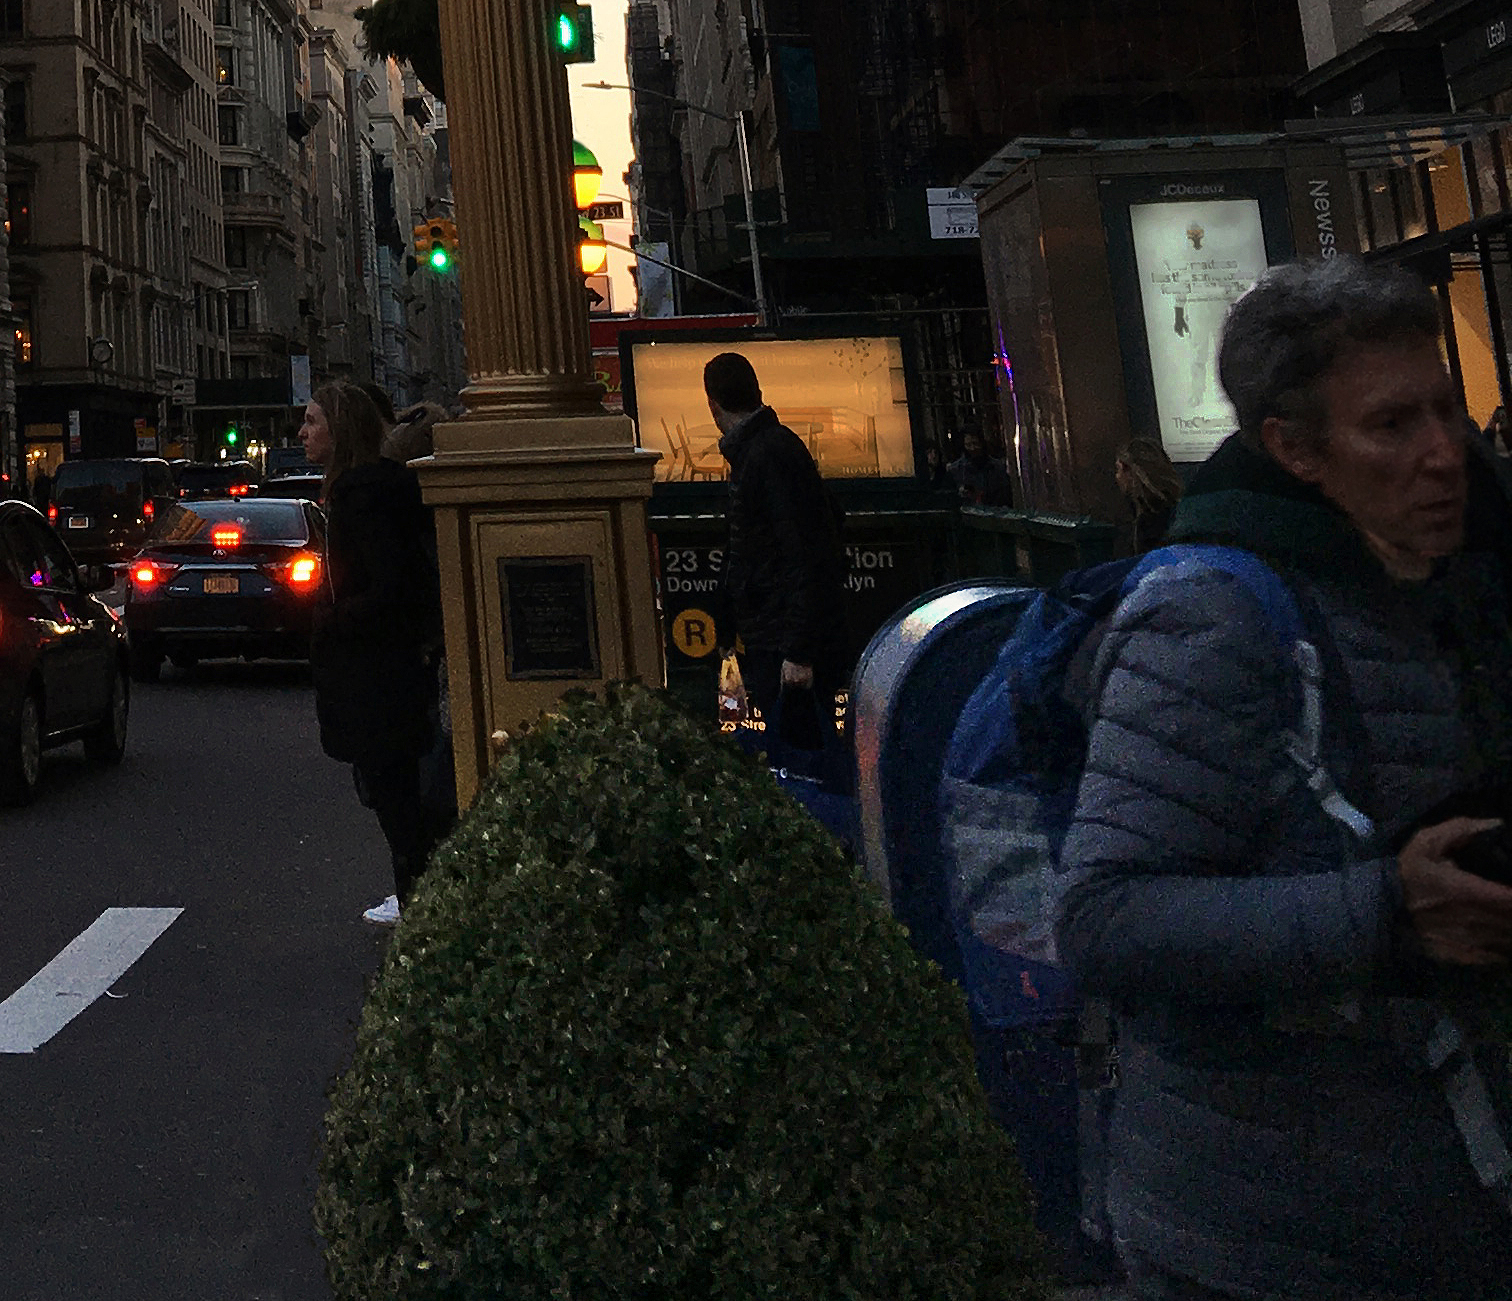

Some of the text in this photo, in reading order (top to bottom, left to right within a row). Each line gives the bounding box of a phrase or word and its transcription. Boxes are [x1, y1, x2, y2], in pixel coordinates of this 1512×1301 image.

[1159, 183, 1225, 197] JCDecaux
[593, 205, 606, 219] 23
[665, 551, 699, 573] 23
[843, 574, 876, 592] lyn
[684, 619, 707, 647] R
